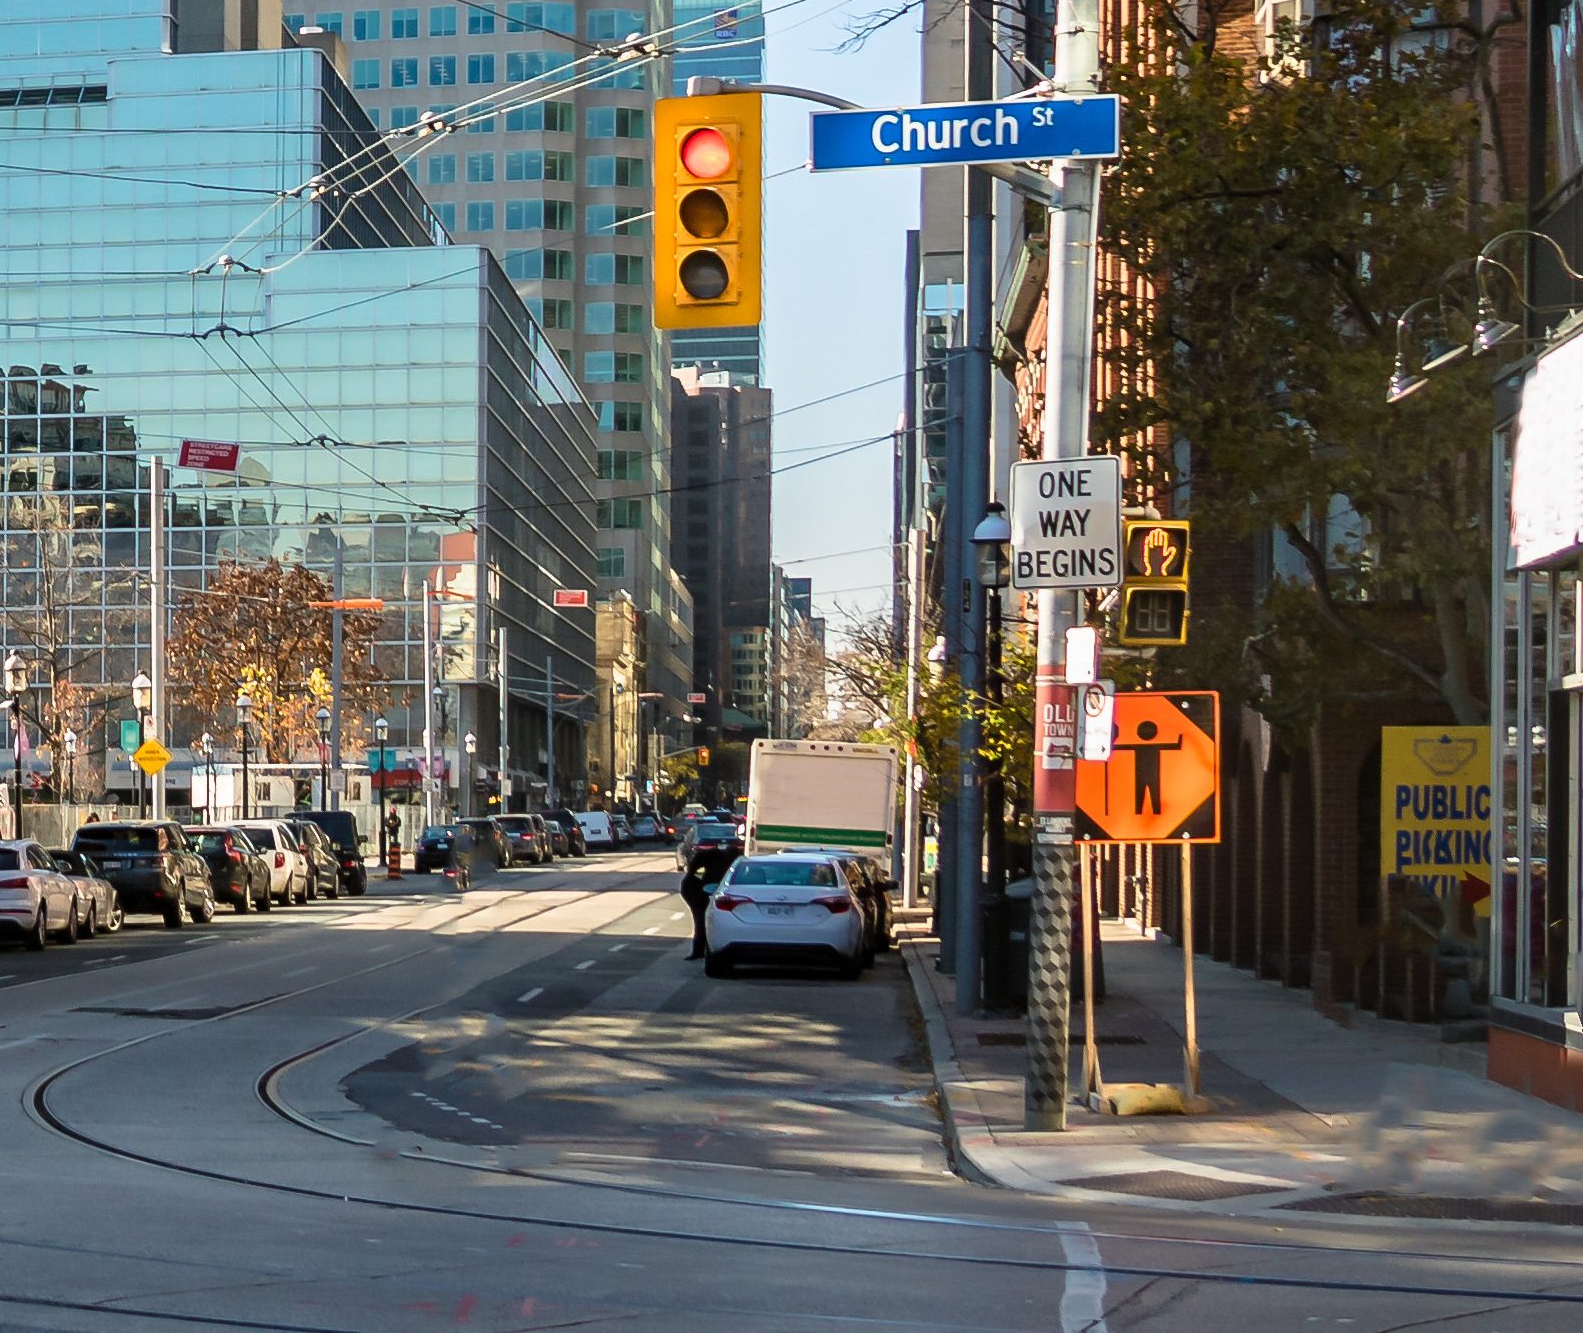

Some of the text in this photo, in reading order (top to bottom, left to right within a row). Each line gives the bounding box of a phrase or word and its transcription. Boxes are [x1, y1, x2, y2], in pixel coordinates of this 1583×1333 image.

[871, 106, 1054, 153] Church St
[187, 454, 210, 462] SPEED
[1038, 469, 1092, 499] ONE
[1038, 508, 1091, 538] WAY
[1017, 547, 1115, 579] BEGINS
[1043, 723, 1074, 736] TOWN
[1395, 784, 1491, 821] PUBLIC
